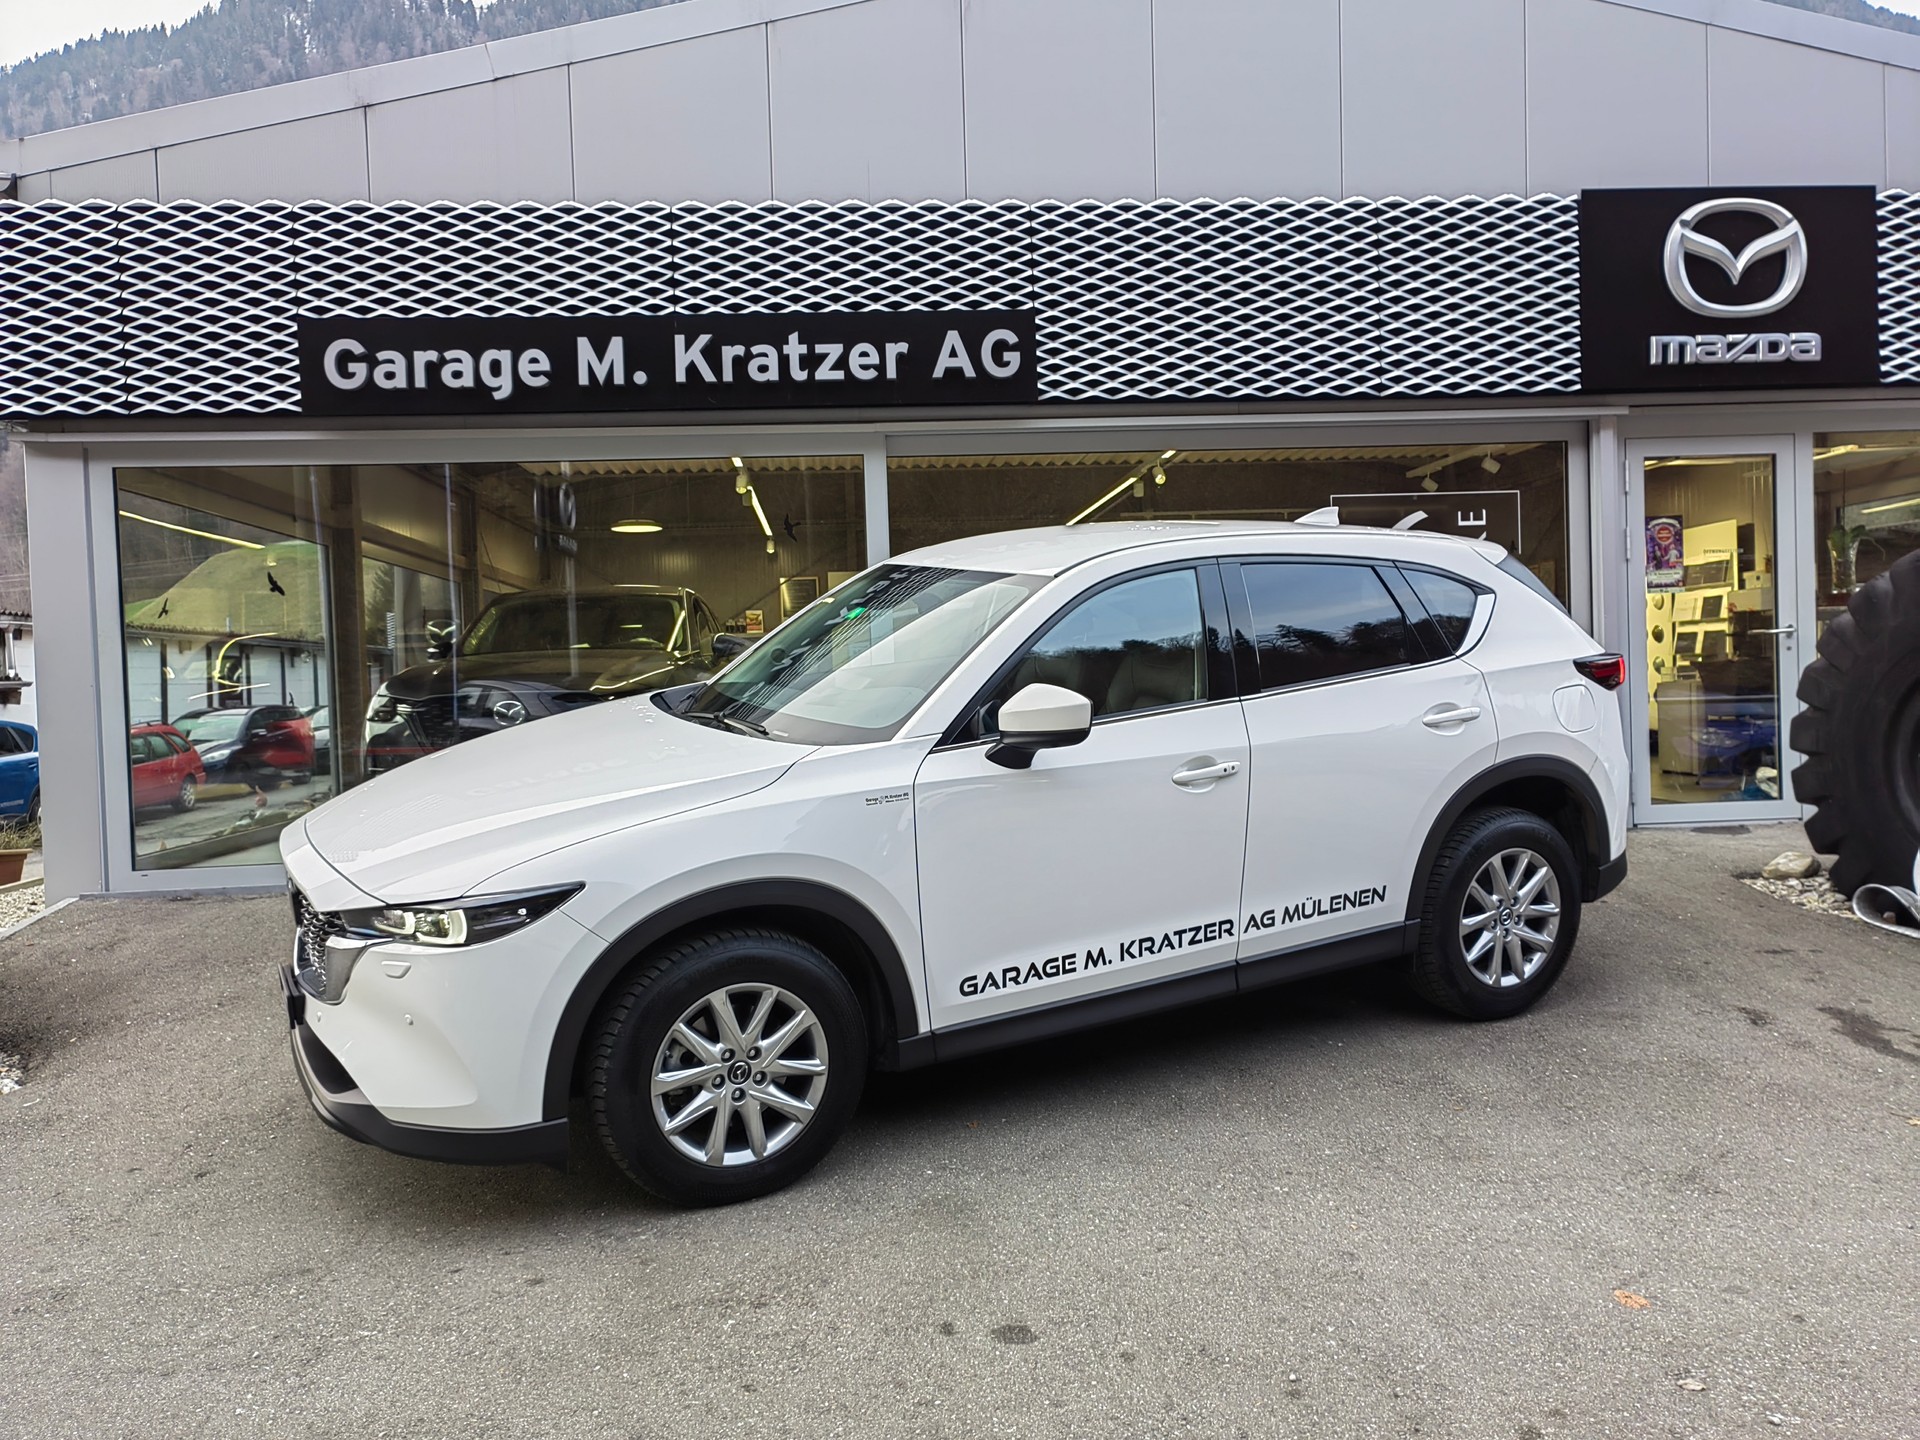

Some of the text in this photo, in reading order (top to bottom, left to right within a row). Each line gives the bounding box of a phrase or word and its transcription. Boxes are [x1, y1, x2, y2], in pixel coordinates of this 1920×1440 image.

[324, 328, 1021, 400] Garage M. Kratzer AG
[959, 884, 1388, 997] GARAGE M. KRATZER AG MÜLENEN
